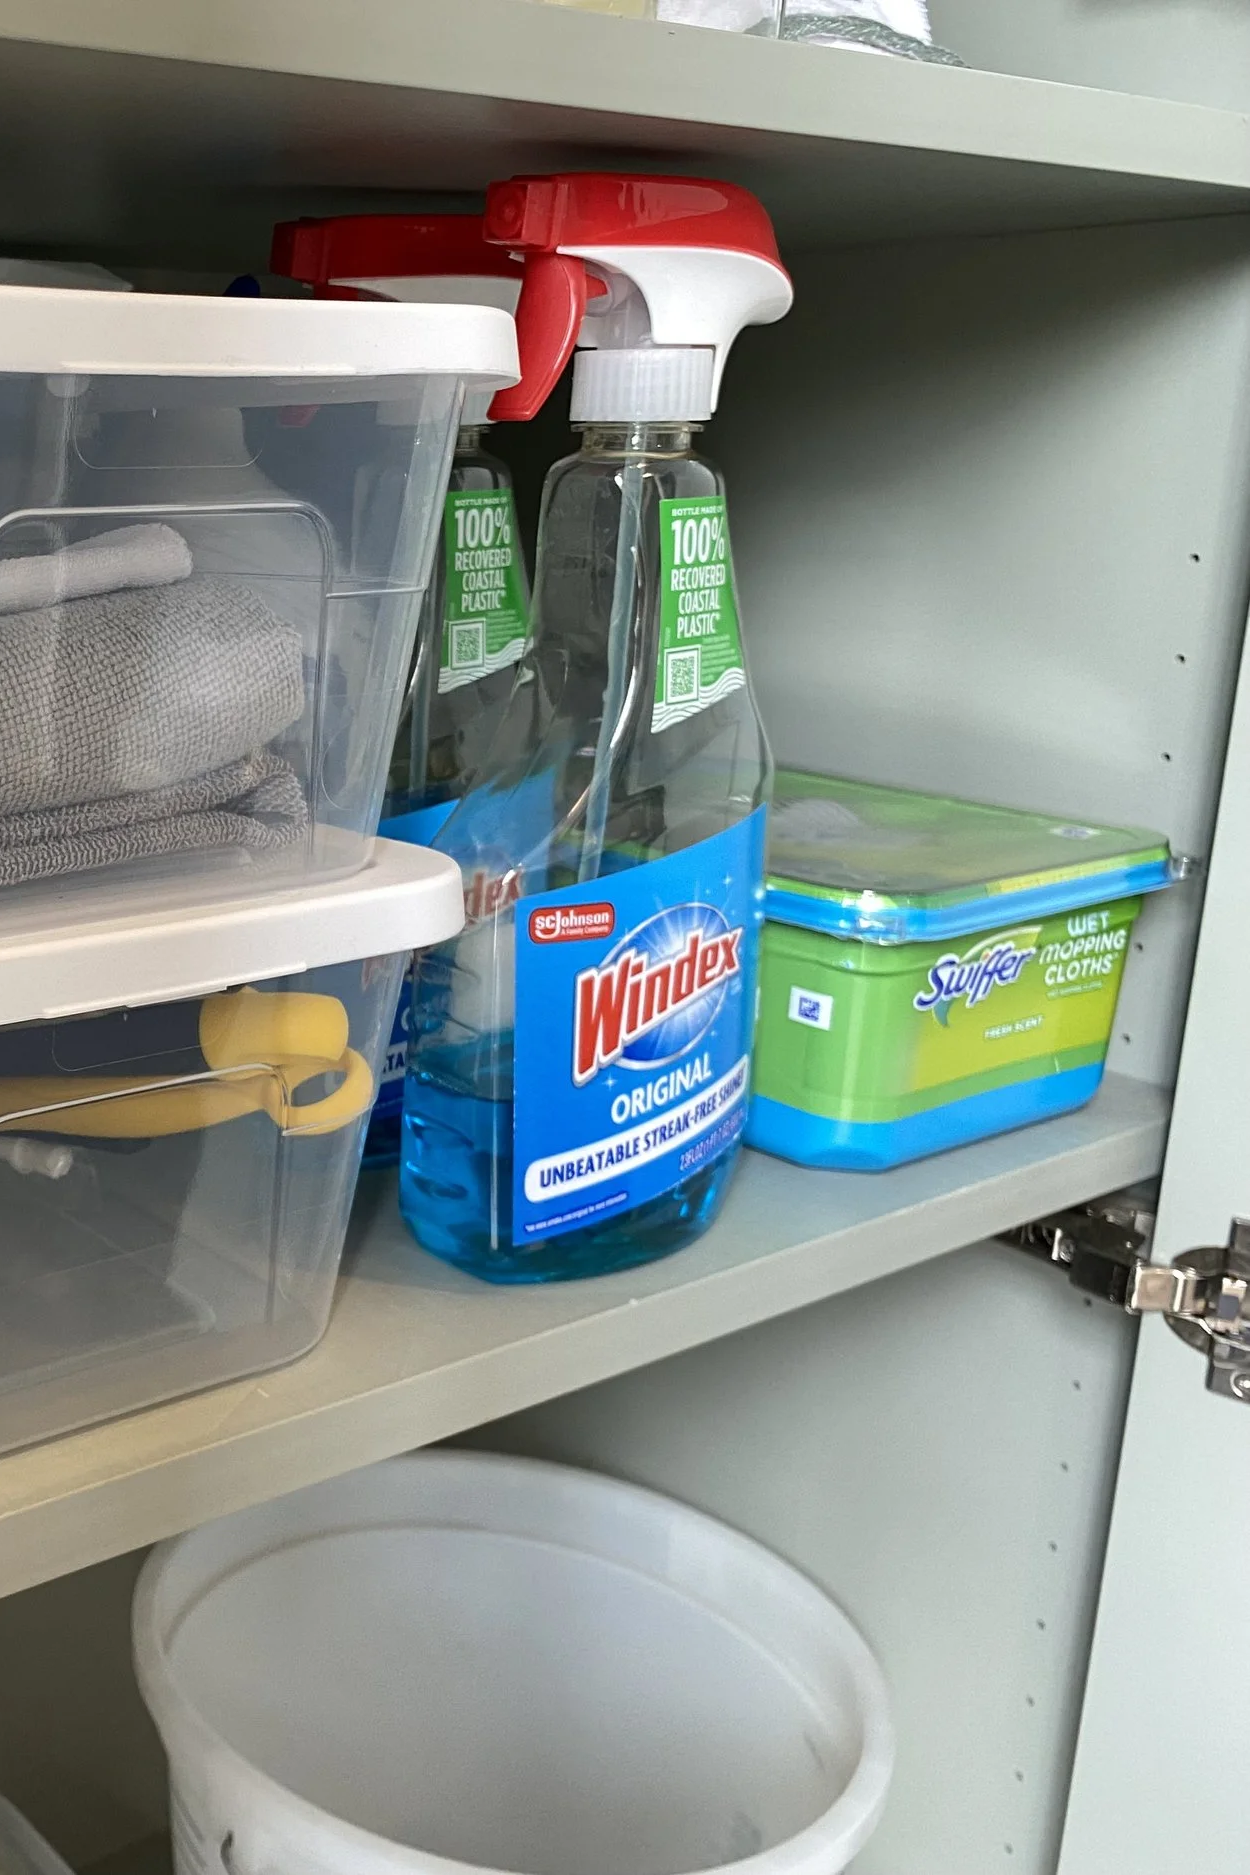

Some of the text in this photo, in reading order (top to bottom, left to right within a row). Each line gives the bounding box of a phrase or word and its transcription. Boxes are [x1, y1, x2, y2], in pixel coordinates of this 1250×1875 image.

[454, 506, 511, 549] 100%
[671, 507, 699, 517] BOTTLE
[700, 506, 717, 514] MADE
[671, 517, 725, 566] 100%
[454, 548, 511, 572] RECOVERED
[462, 569, 506, 592] COASTAL
[671, 563, 726, 591] RECOVERED
[678, 588, 721, 615] COASTAL
[1067, 910, 1110, 937] WET
[1039, 929, 1127, 965] MOPPING
[915, 943, 1035, 1008] Swiffer
[574, 929, 741, 1082] Windex
[1014, 1015, 1043, 1032] SCENT
[610, 1051, 712, 1124] ORIGINAL
[539, 1136, 640, 1188] UNBEATABLE
[643, 1092, 717, 1152] STREAK-FREE
